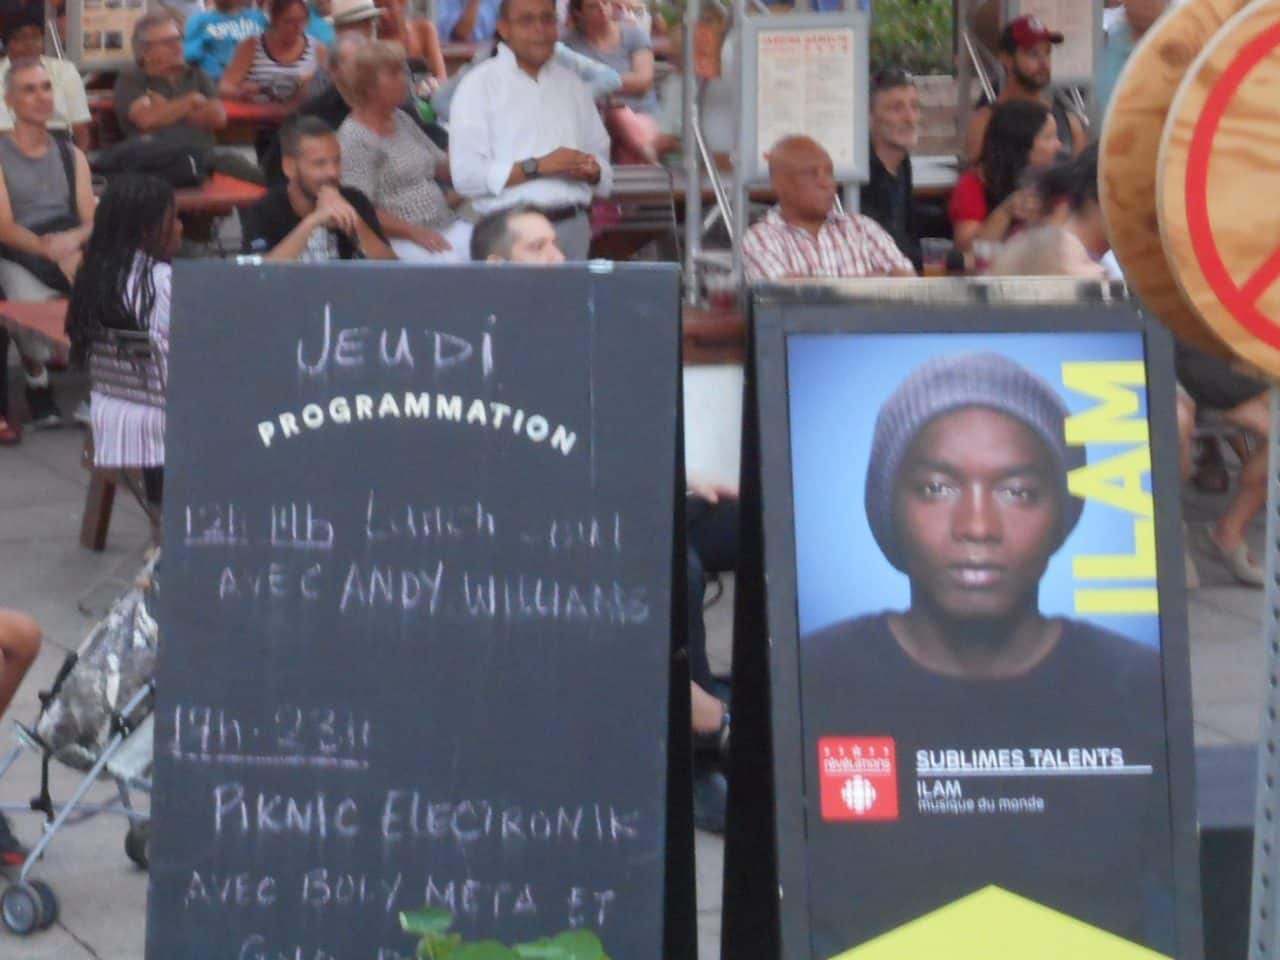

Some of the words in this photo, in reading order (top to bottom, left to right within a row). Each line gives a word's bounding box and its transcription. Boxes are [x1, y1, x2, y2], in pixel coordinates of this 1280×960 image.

[258, 392, 576, 456] PROGRAMMATION
[1061, 360, 1159, 614] ILAM
[339, 559, 444, 617] ANDY
[915, 748, 1025, 770] SUBLIMES
[1029, 746, 1125, 769] TALENTS
[916, 779, 962, 799] ILAM
[918, 795, 974, 815] musique
[978, 795, 996, 813] du
[999, 793, 1045, 813] monde
[183, 869, 277, 912] AVEC
